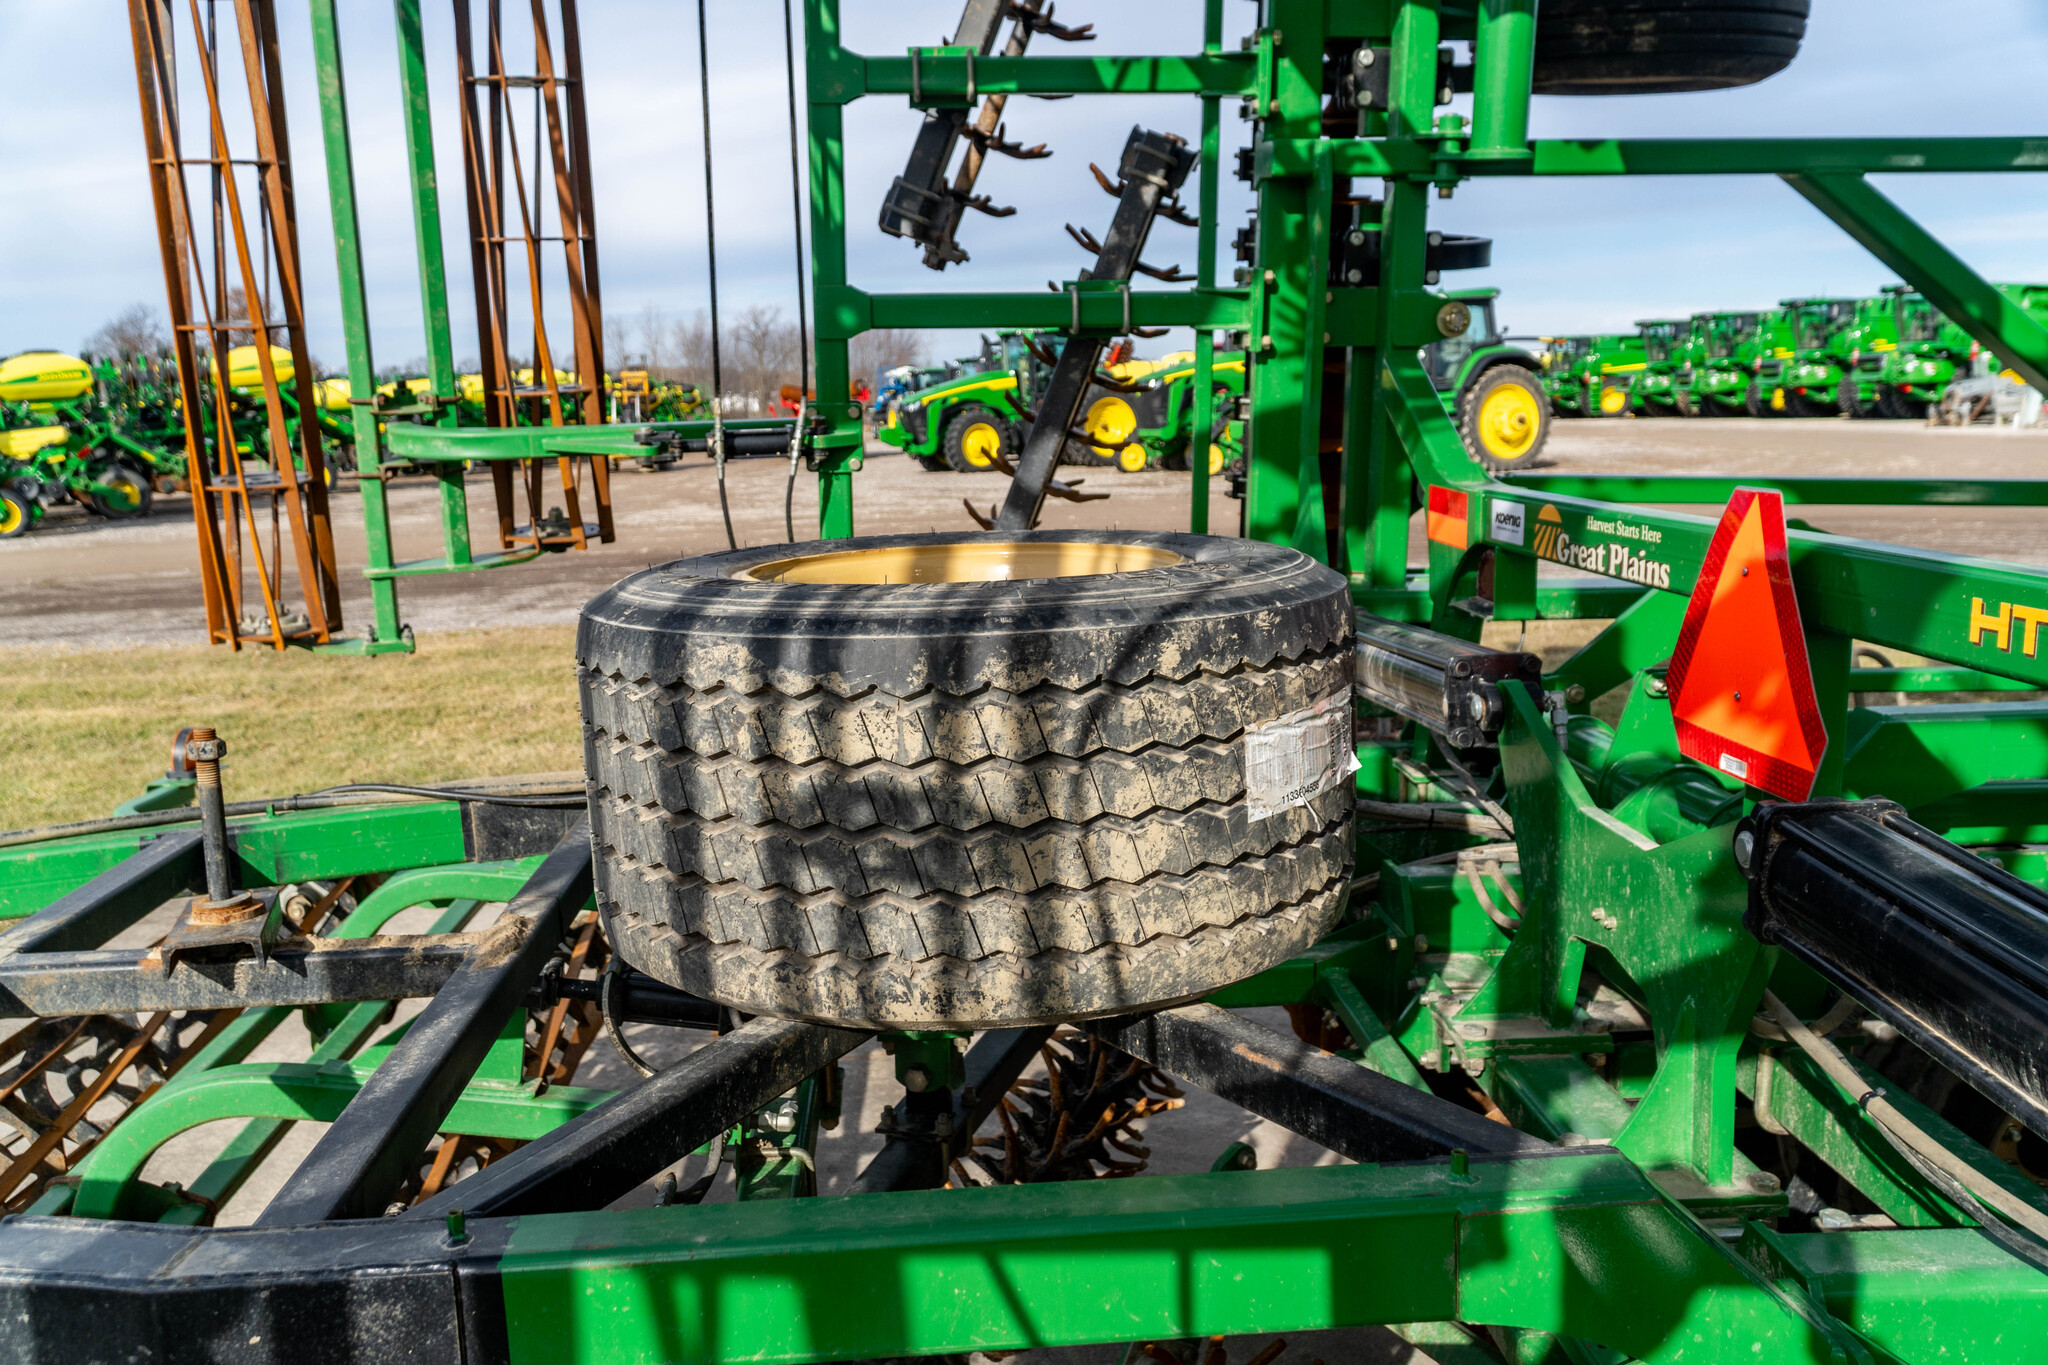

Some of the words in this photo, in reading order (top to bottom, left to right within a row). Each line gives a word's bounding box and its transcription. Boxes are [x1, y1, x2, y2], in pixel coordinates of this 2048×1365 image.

[1587, 515, 1616, 534] Harvest
[1616, 520, 1640, 539] Starts
[1641, 524, 1662, 543] Here
[1556, 532, 1606, 574] Great
[1607, 542, 1670, 589] Plains
